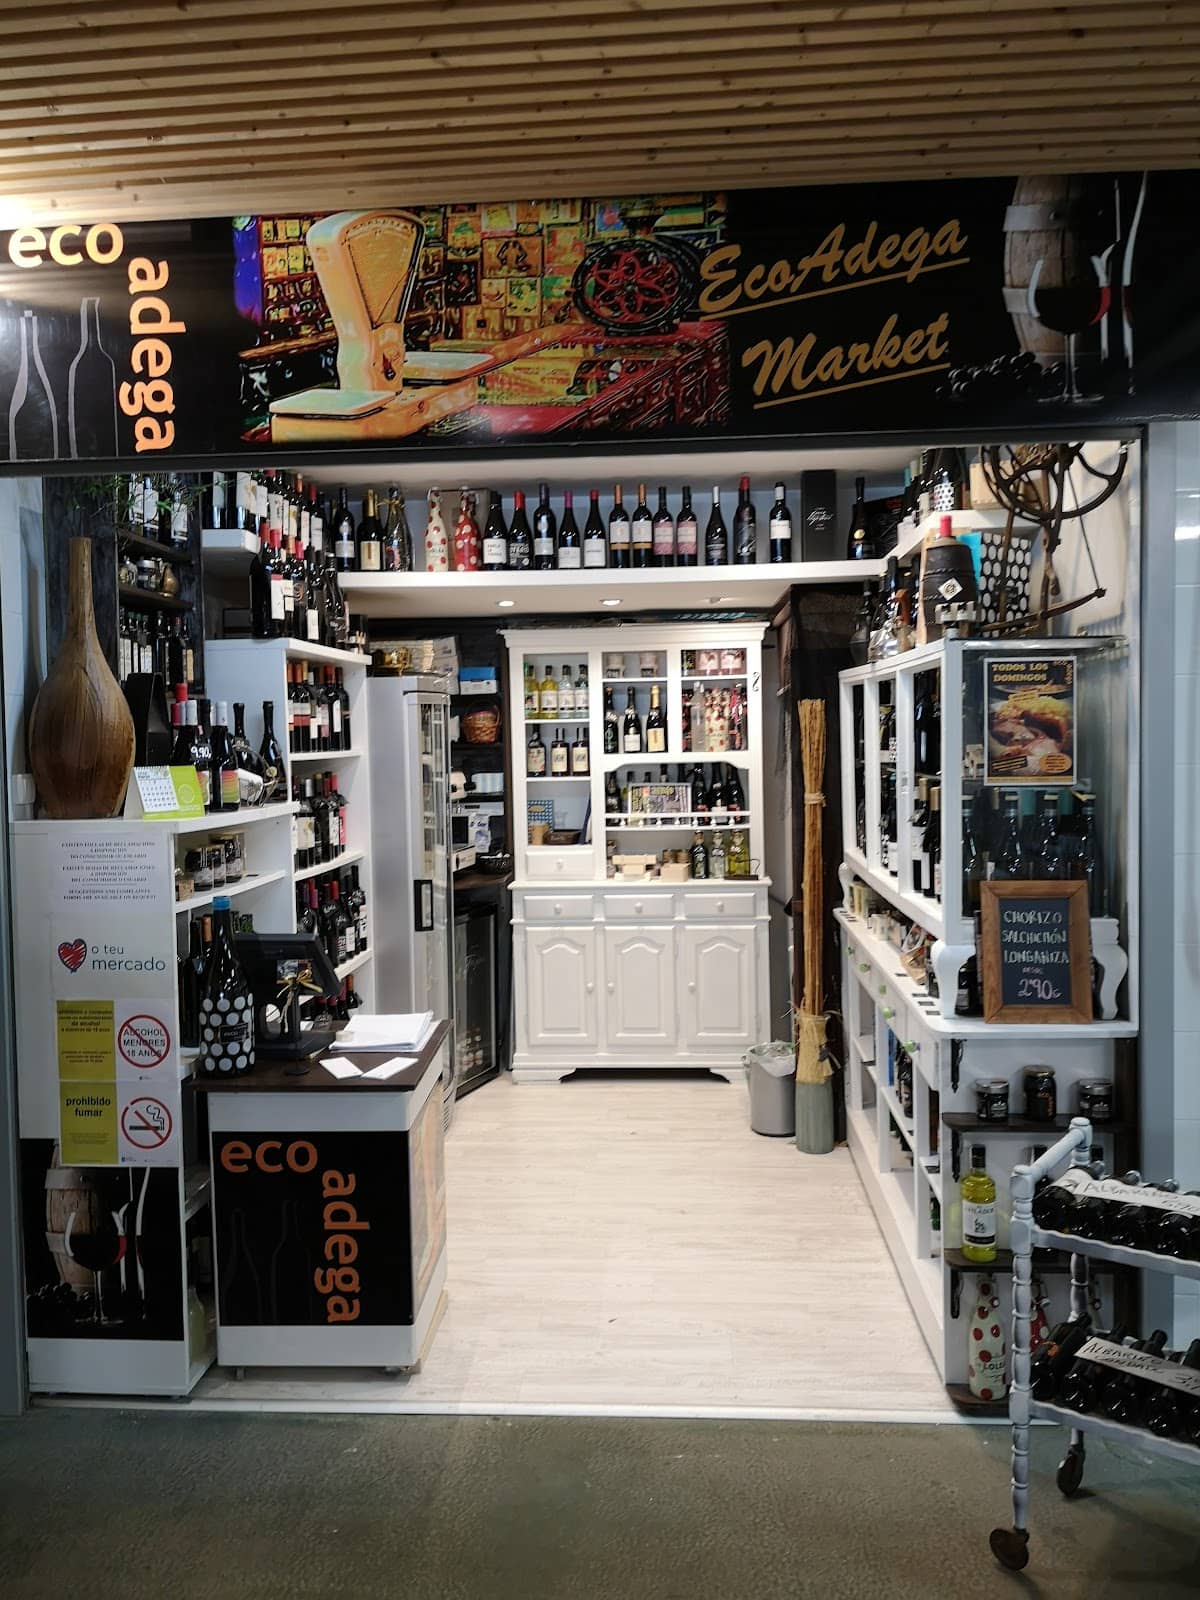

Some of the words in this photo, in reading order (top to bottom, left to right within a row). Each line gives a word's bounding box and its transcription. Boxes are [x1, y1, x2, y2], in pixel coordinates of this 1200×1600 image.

[8, 223, 124, 268] eco
[700, 219, 967, 313] EcoAdega
[118, 256, 187, 453] adega
[741, 311, 950, 397] Market
[991, 663, 1026, 672] TODOS
[1029, 662, 1049, 671] LOS
[992, 673, 1047, 682] DOMINGOS
[1003, 910, 1062, 924] CHORIZO
[91, 945, 99, 954] o
[104, 944, 124, 955] teu
[91, 956, 166, 971] mercado
[123, 1028, 164, 1036] ALCOHOL
[123, 1039, 166, 1047] MENORES
[65, 1095, 111, 1106] prohibido
[75, 1107, 103, 1117] fumar
[220, 1140, 318, 1173] eco
[313, 1169, 371, 1324] adega
